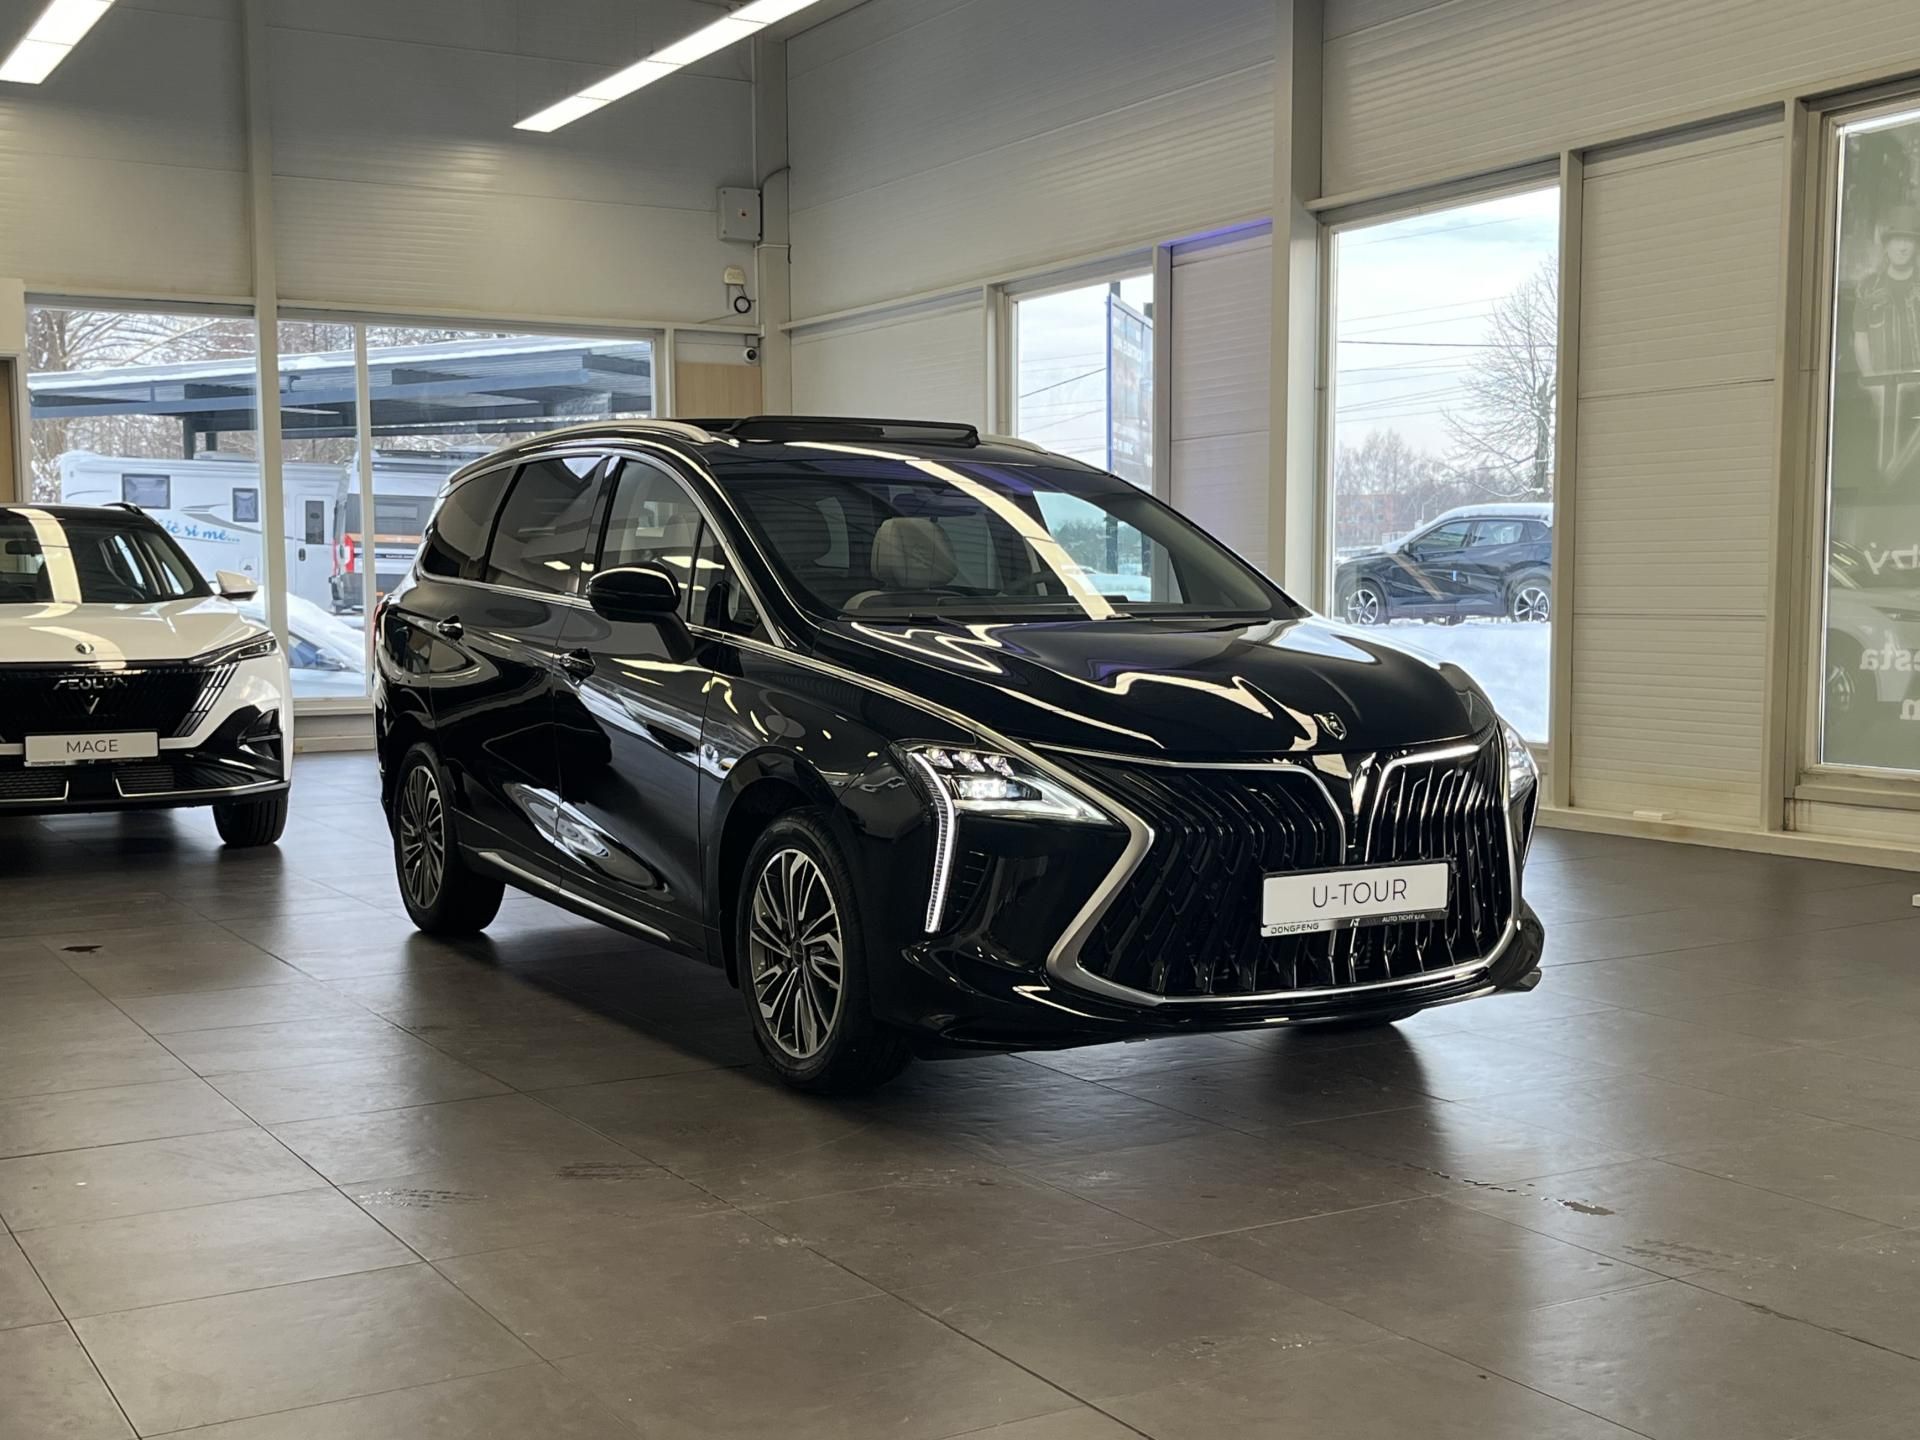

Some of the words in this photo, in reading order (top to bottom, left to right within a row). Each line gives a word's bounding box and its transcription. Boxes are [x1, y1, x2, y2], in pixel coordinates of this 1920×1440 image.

[66, 739, 119, 754] MAGE
[1312, 878, 1408, 908] U-TOUR
[1270, 922, 1320, 935] DONGFENG
